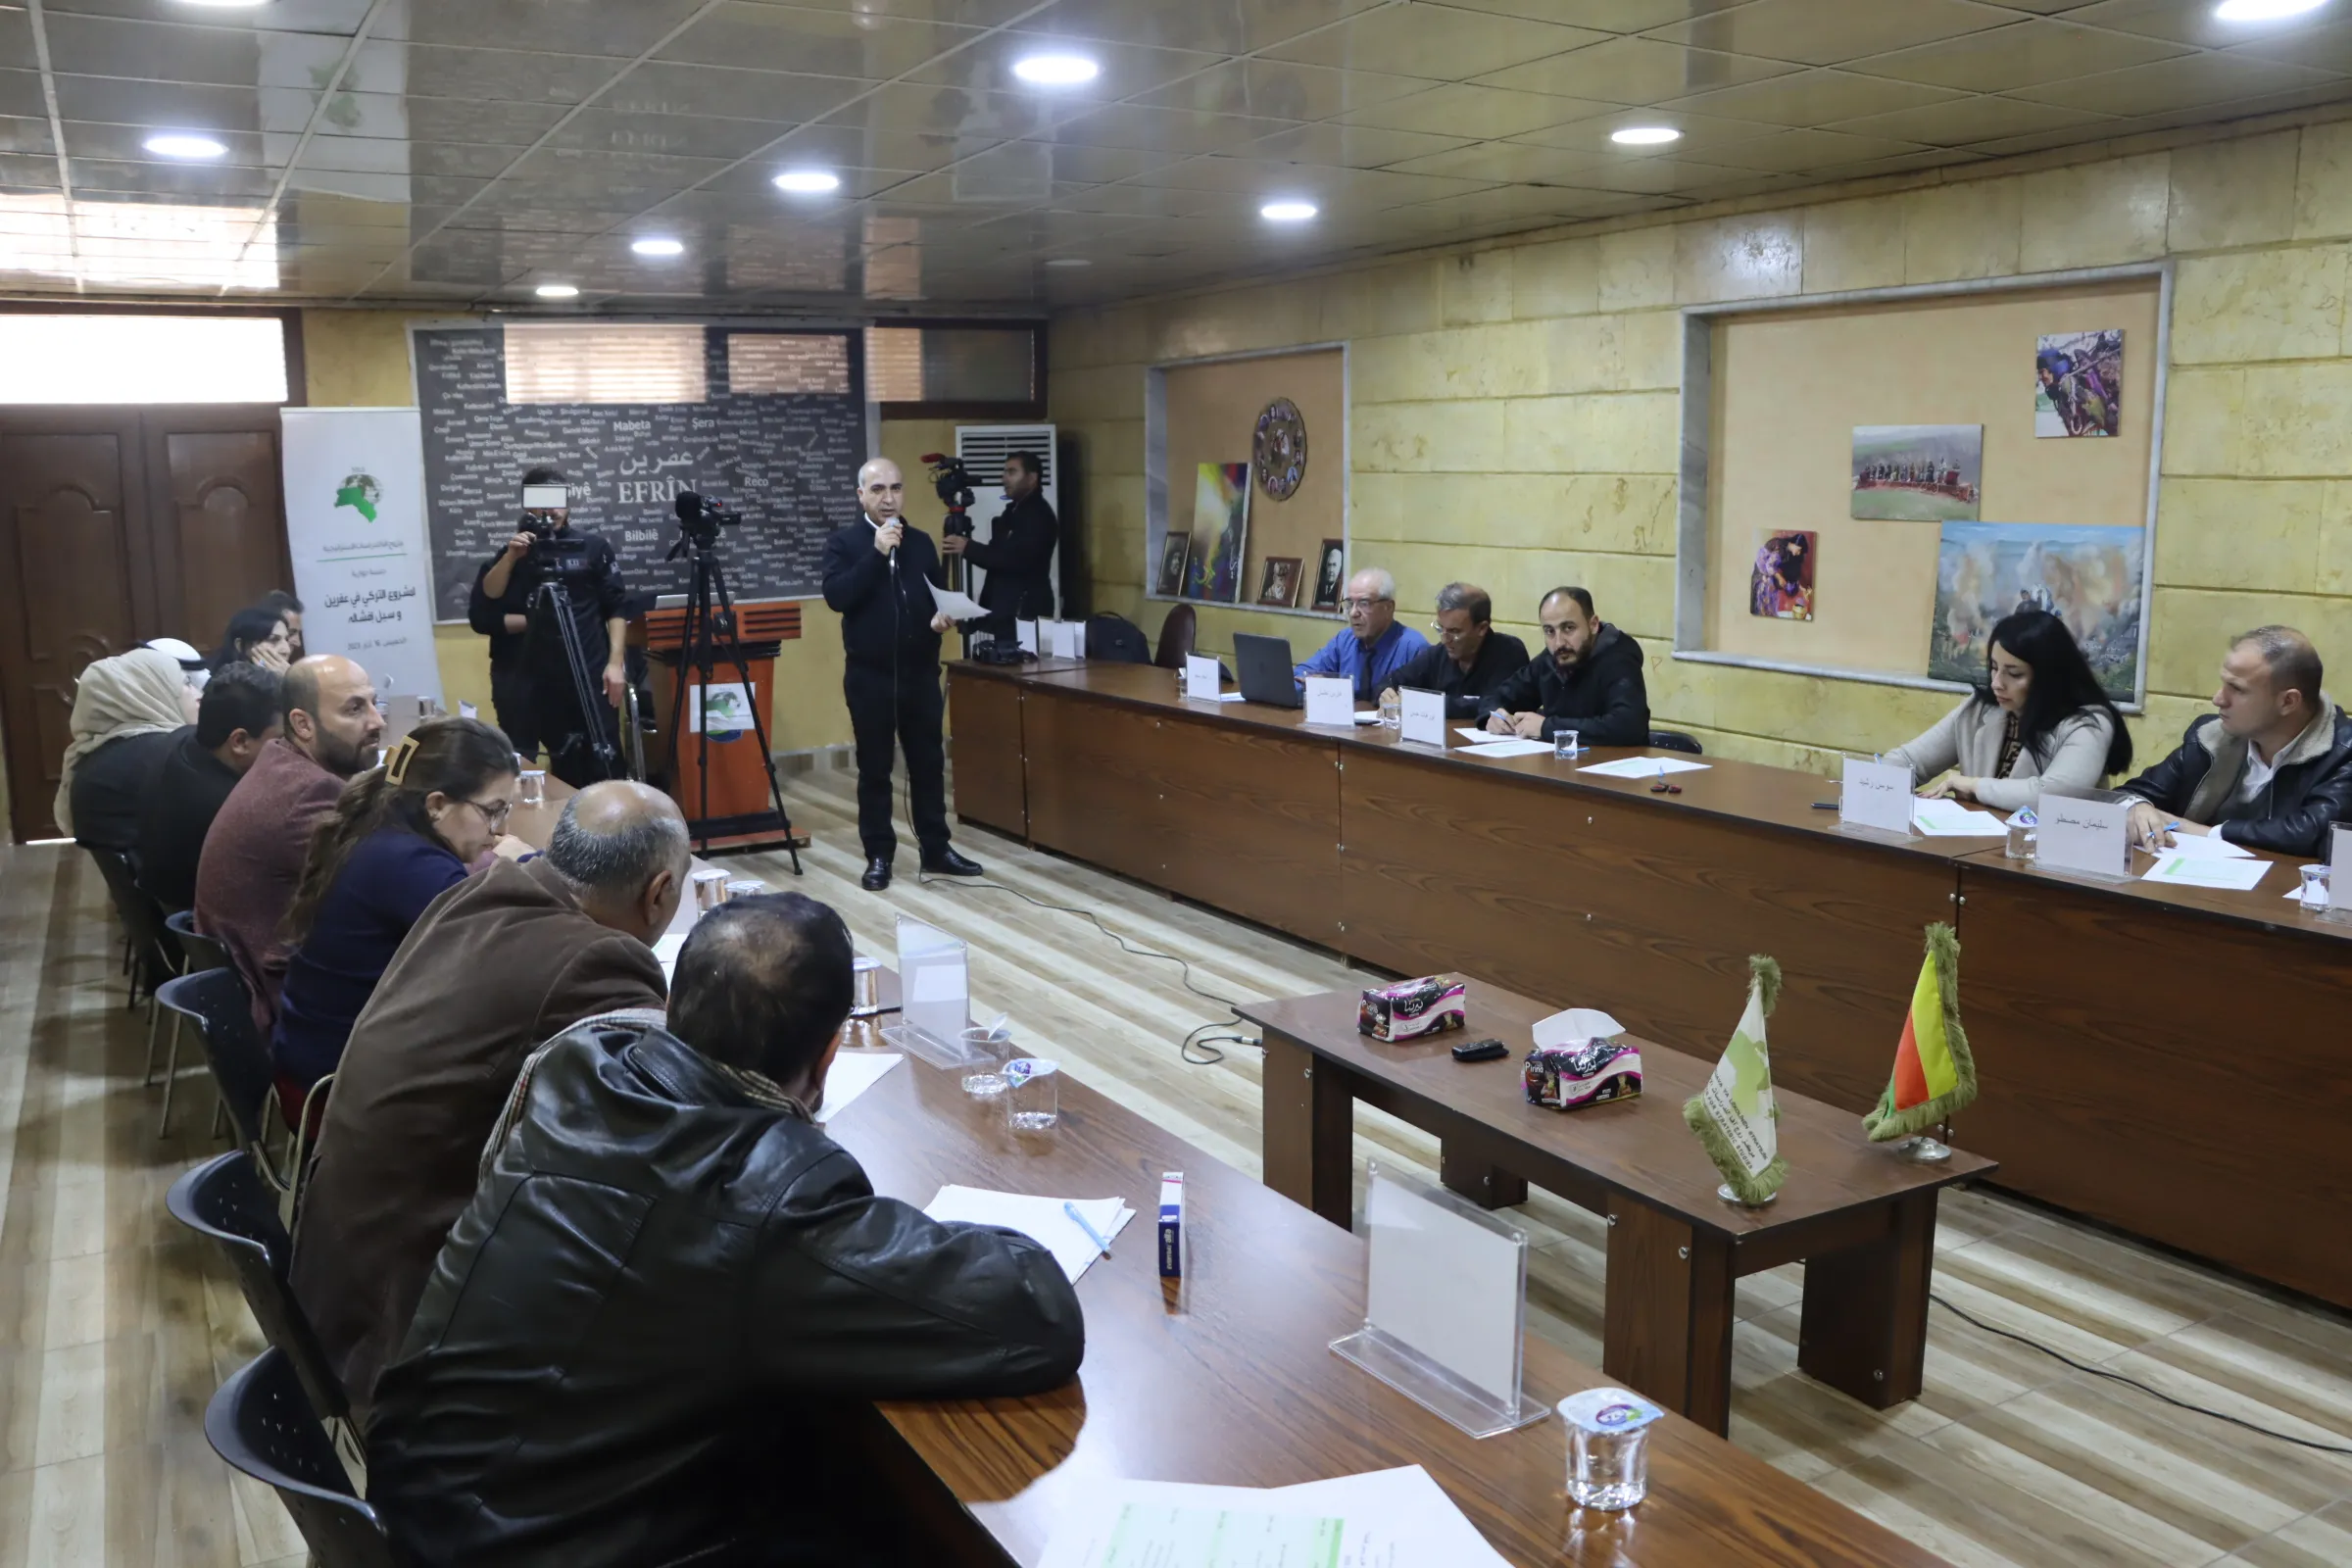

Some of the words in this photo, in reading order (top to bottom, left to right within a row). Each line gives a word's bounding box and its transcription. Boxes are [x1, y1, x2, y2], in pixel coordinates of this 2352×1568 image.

[612, 420, 652, 432] Mabeta
[692, 417, 714, 429] Şera
[619, 446, 694, 475] عفرين
[616, 474, 697, 504] EFRÎN
[744, 476, 769, 487] Reco
[624, 528, 659, 542] Bilbilê
[324, 592, 349, 608] عفرين
[350, 591, 361, 608] في
[363, 589, 386, 607] التركي
[2082, 817, 2108, 830] سليمان
